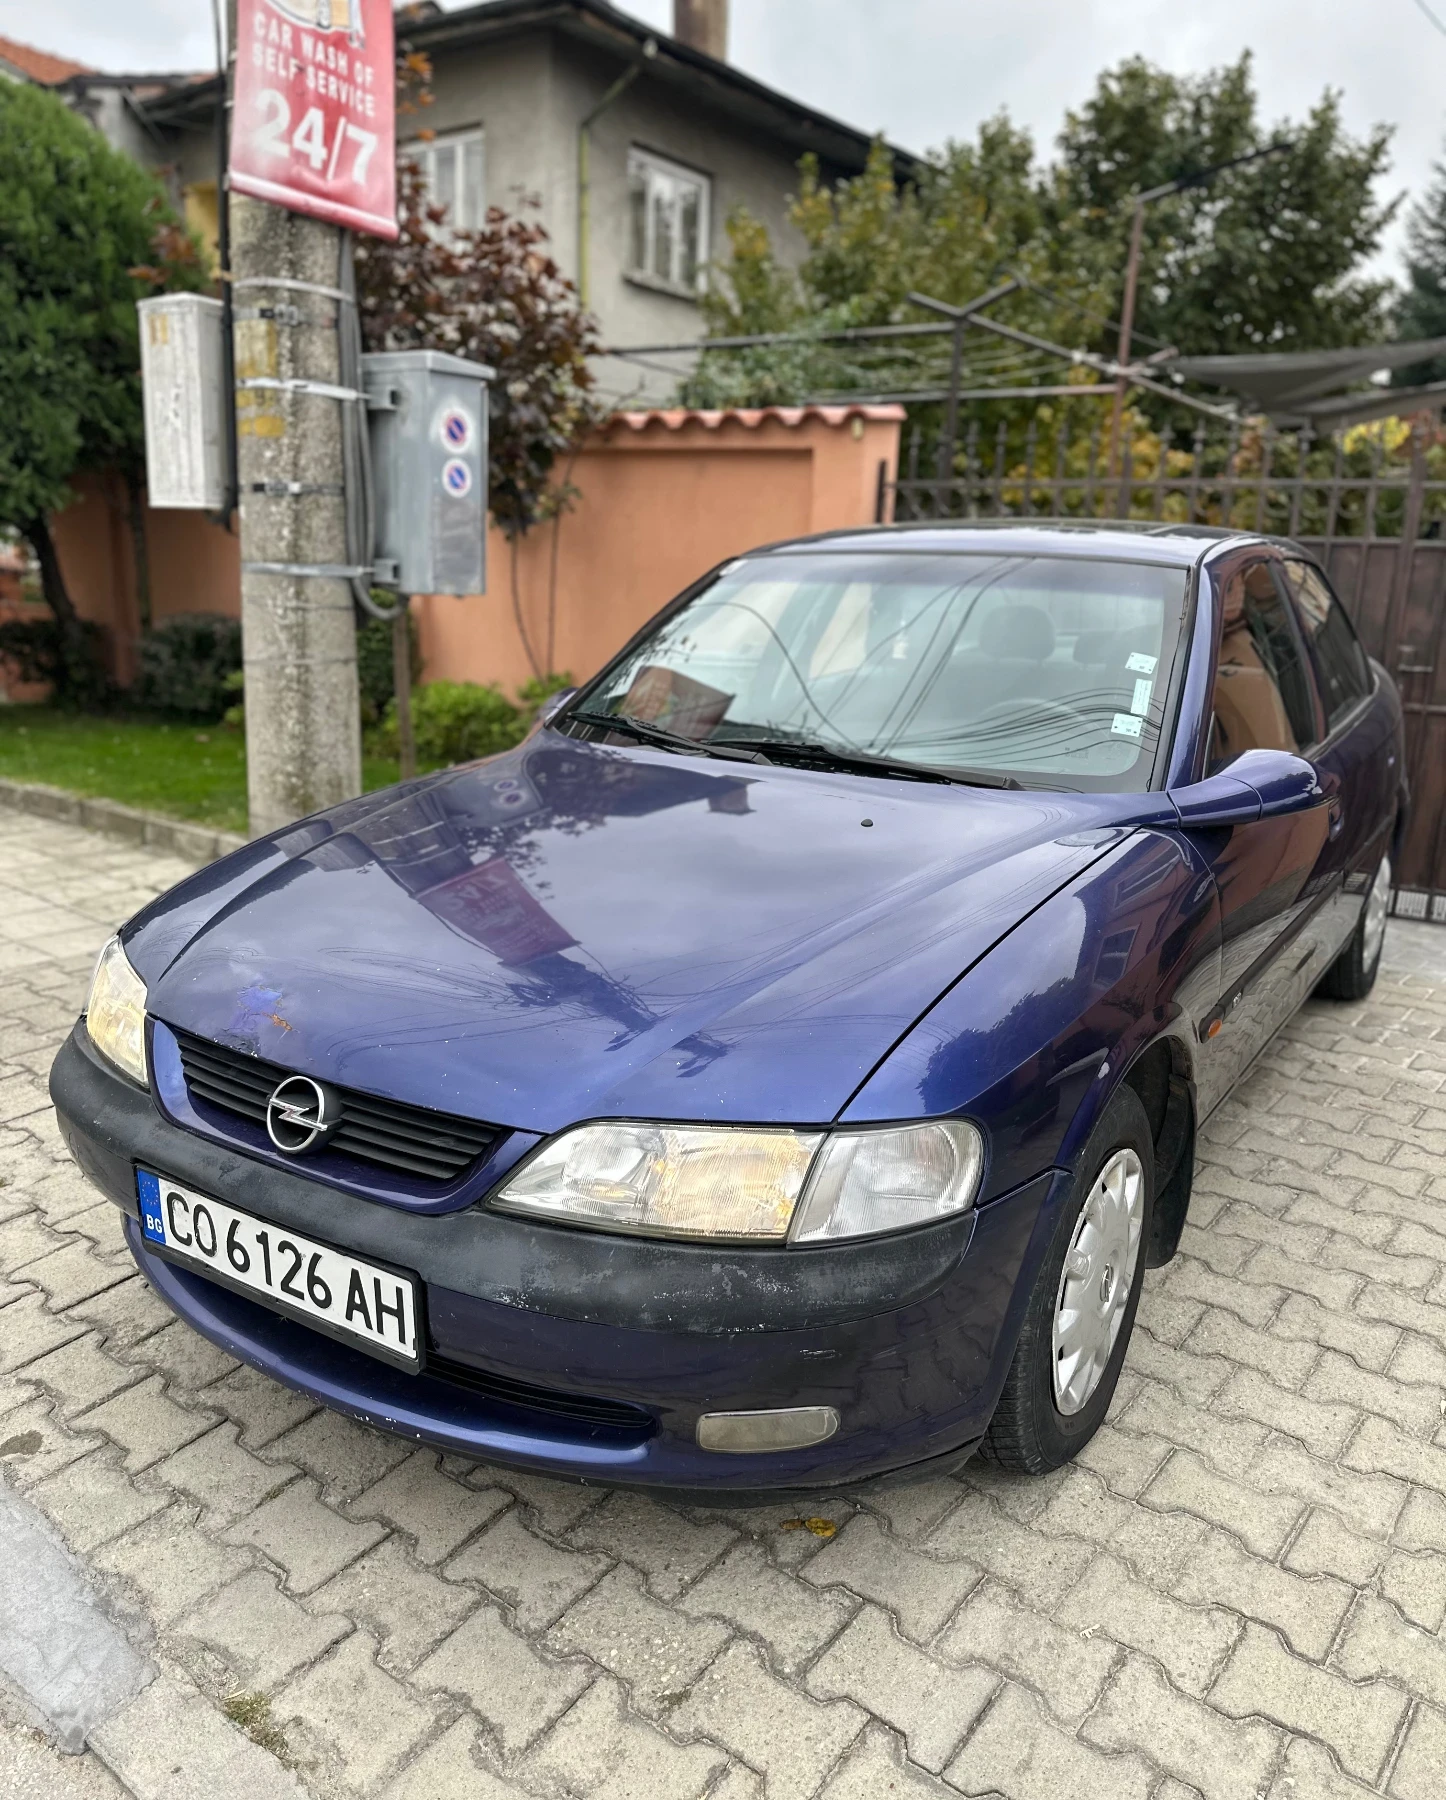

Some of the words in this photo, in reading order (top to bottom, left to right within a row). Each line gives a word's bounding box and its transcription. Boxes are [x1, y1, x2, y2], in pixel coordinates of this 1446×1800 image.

[252, 42, 301, 81] SELF
[306, 65, 375, 118] SERVICE
[253, 12, 293, 49] CAR
[301, 33, 348, 76] WASH
[353, 61, 374, 88] OF
[255, 89, 378, 186] 24/7
[145, 1213, 163, 1234] BG
[226, 1218, 333, 1309] 6126
[345, 1267, 406, 1344] AH
